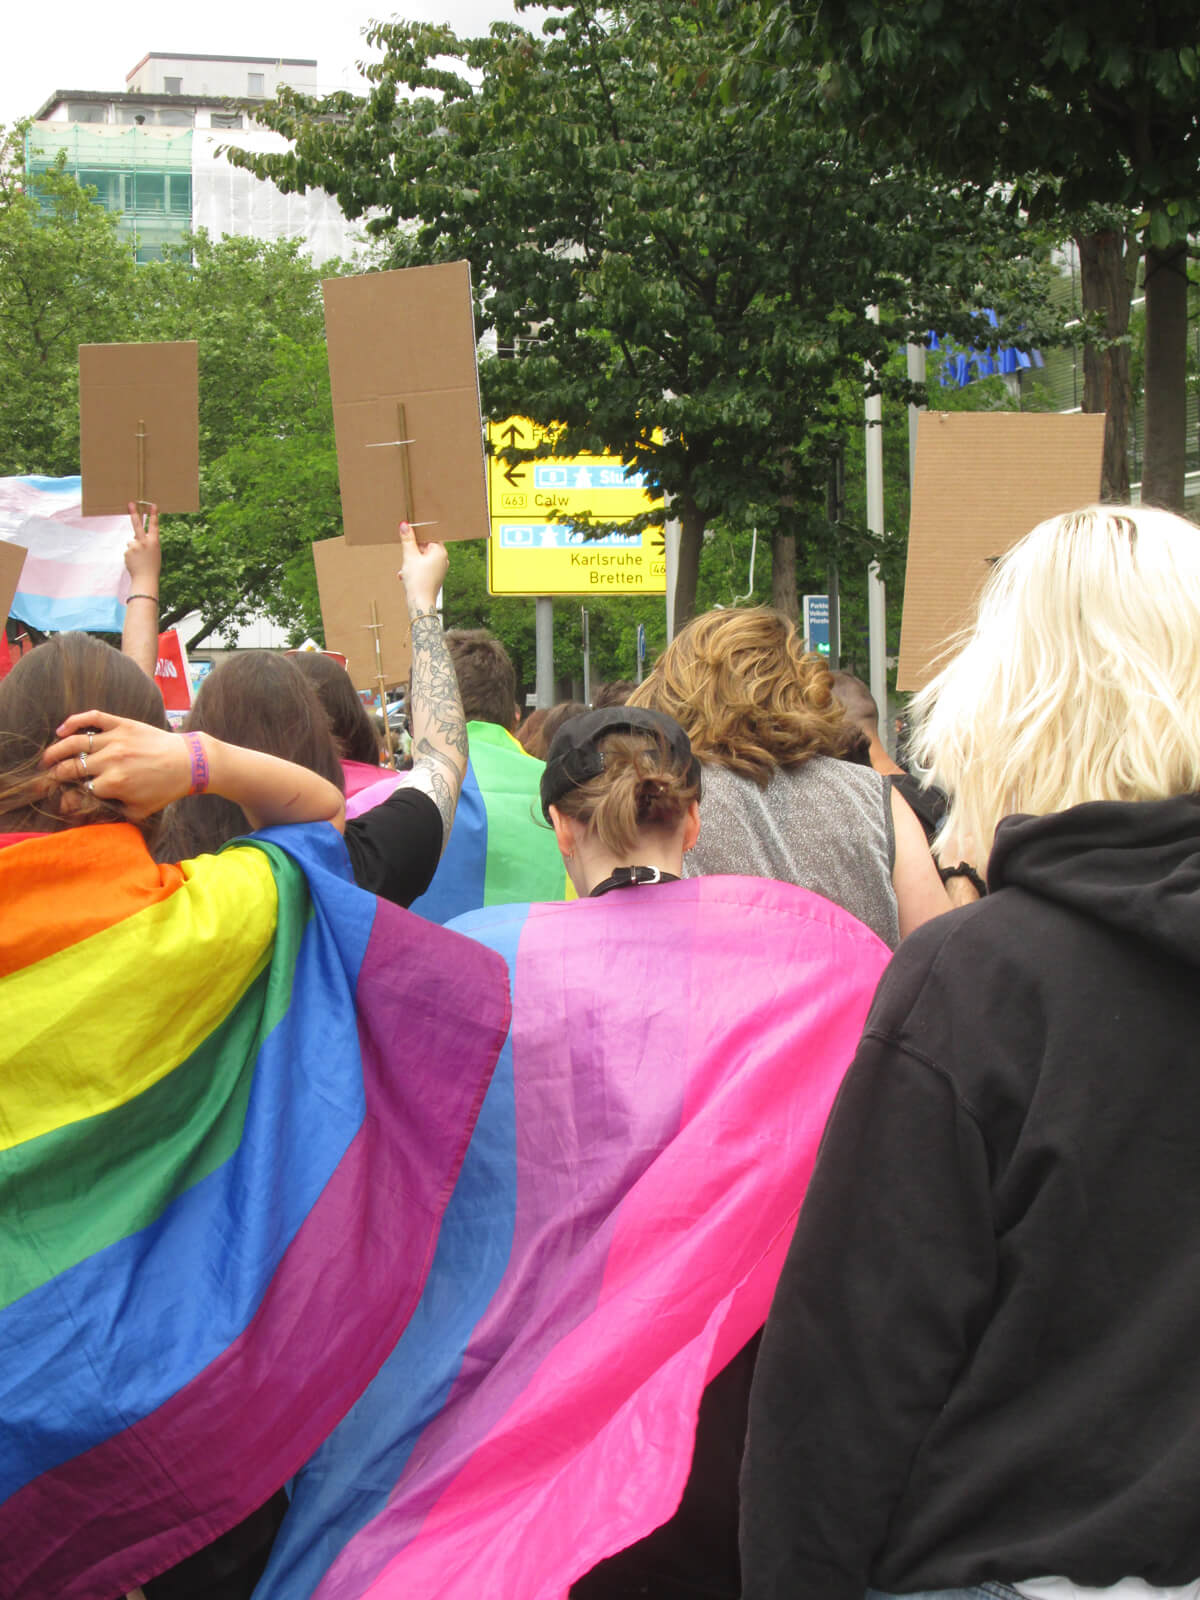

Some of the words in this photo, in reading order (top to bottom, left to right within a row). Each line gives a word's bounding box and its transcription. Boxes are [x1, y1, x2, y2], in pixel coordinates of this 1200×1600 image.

[532, 429, 559, 441] Fre
[505, 495, 524, 506] 463
[535, 494, 569, 506] Calw
[571, 553, 643, 566] Karlsruhe
[653, 563, 666, 573] 46
[590, 571, 643, 584] Bretten
